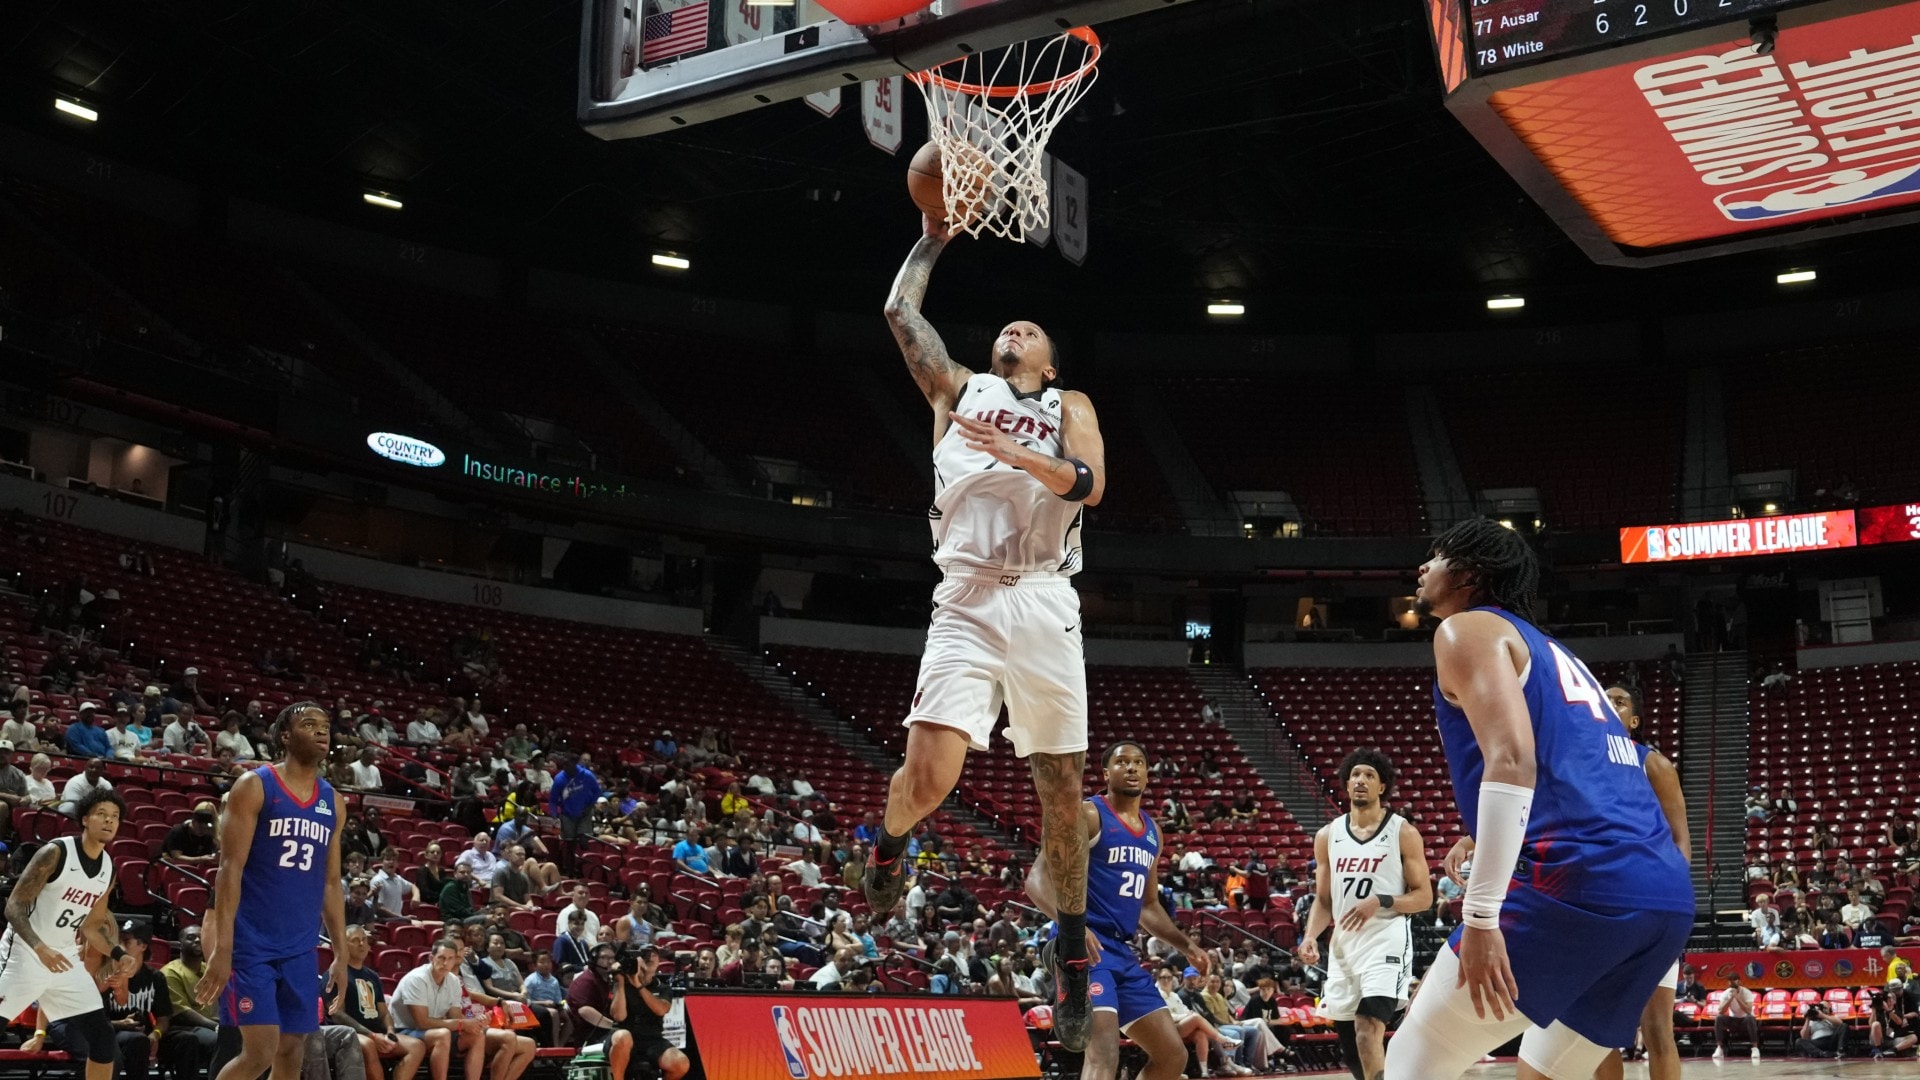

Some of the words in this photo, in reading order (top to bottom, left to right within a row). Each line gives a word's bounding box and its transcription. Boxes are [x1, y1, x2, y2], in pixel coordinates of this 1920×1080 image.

[1475, 19, 1493, 36] 77
[1500, 11, 1539, 30] Ausar
[1596, 13, 1609, 34] 6
[1634, 4, 1648, 26] 2
[1478, 49, 1497, 66] 78
[1502, 40, 1544, 59] White
[1633, 42, 1829, 186] SUMMER
[86, 158, 113, 179] 211
[1066, 195, 1078, 229] 12
[399, 243, 426, 264] 212
[690, 296, 717, 315] 213
[1834, 300, 1862, 317] 217
[1251, 339, 1276, 353] 215
[1535, 330, 1562, 345] 216
[377, 434, 435, 459] COUNTRY
[463, 453, 562, 493] Insurance
[43, 490, 78, 519] 107
[1667, 521, 1752, 557] SUMMER
[1756, 515, 1828, 551] LEAGUE
[473, 583, 502, 606] 108
[269, 817, 331, 846] DETROIT
[279, 839, 315, 872] 23
[1336, 854, 1387, 873] HEAT
[61, 886, 103, 908] HEAT
[1118, 871, 1146, 900] 20
[1343, 877, 1373, 899] 70
[55, 908, 88, 932] 64
[796, 1007, 909, 1078] SUMMER
[897, 1007, 983, 1072] LEAGUE
